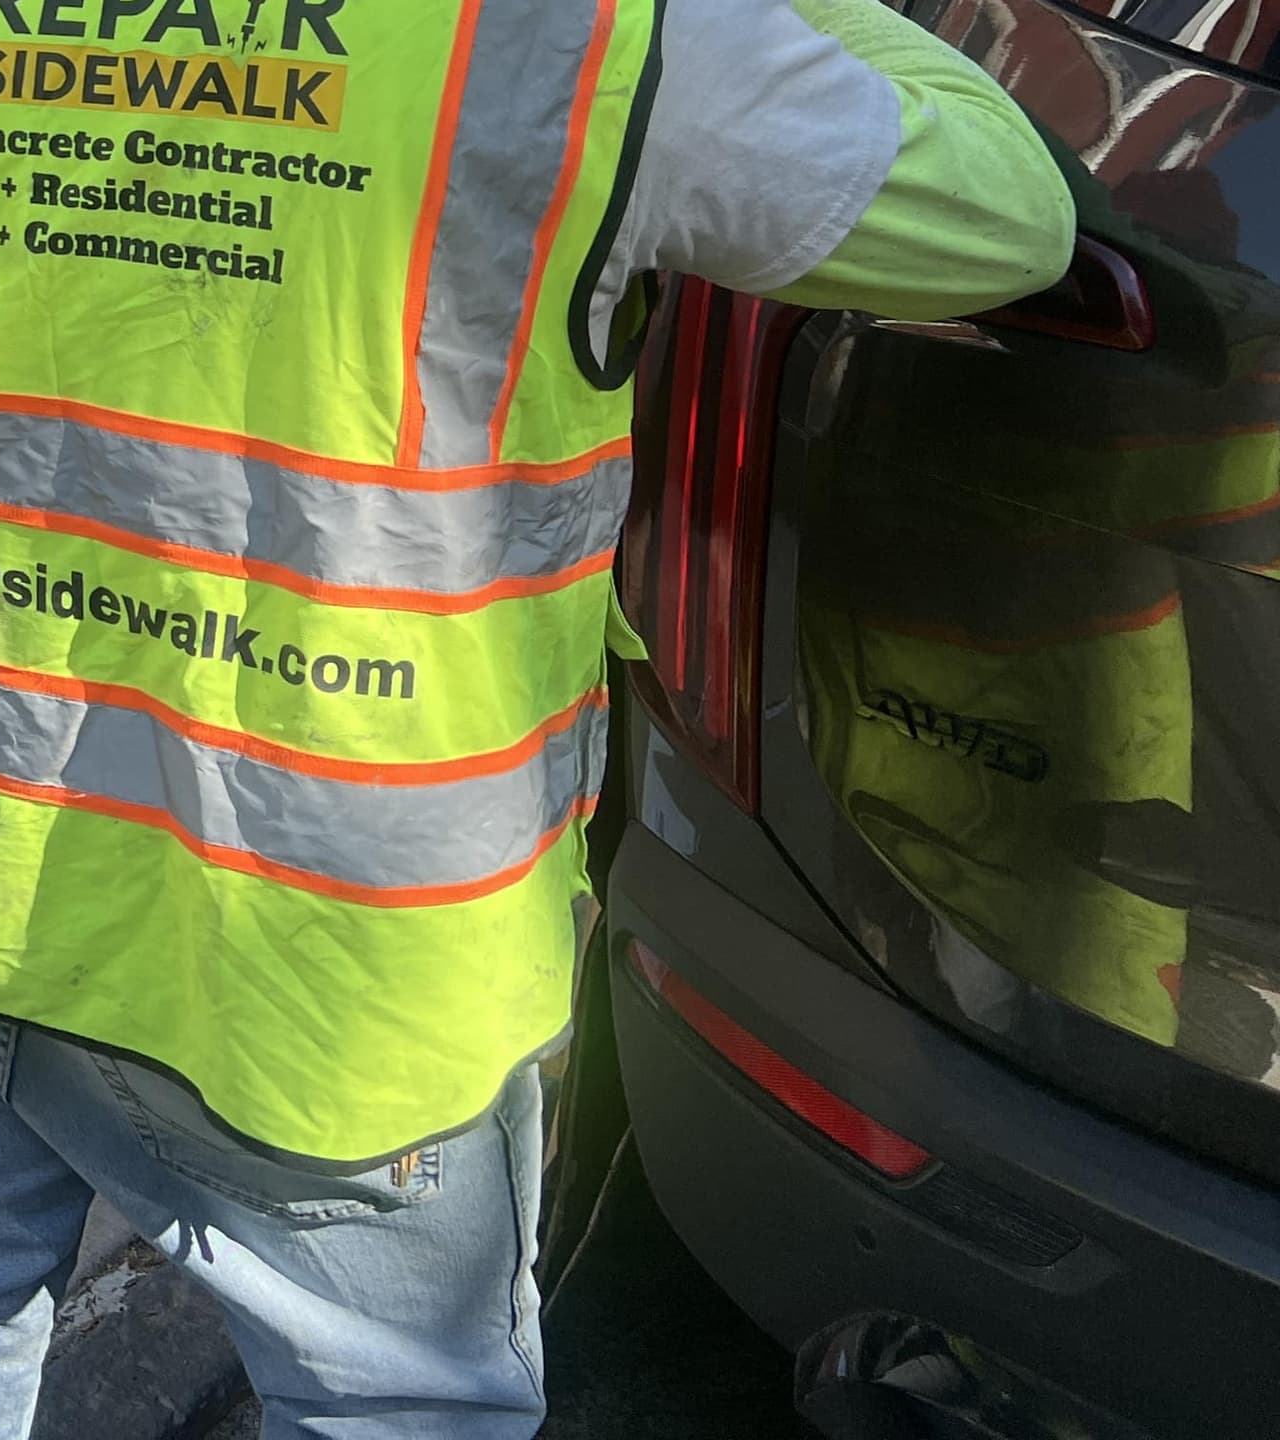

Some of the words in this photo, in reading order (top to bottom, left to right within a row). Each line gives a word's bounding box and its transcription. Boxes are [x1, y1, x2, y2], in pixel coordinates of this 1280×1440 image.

[123, 130, 372, 192] Contractor
[29, 172, 274, 231] Residential
[23, 220, 285, 285] Commercial
[861, 688, 1048, 782] AWD
